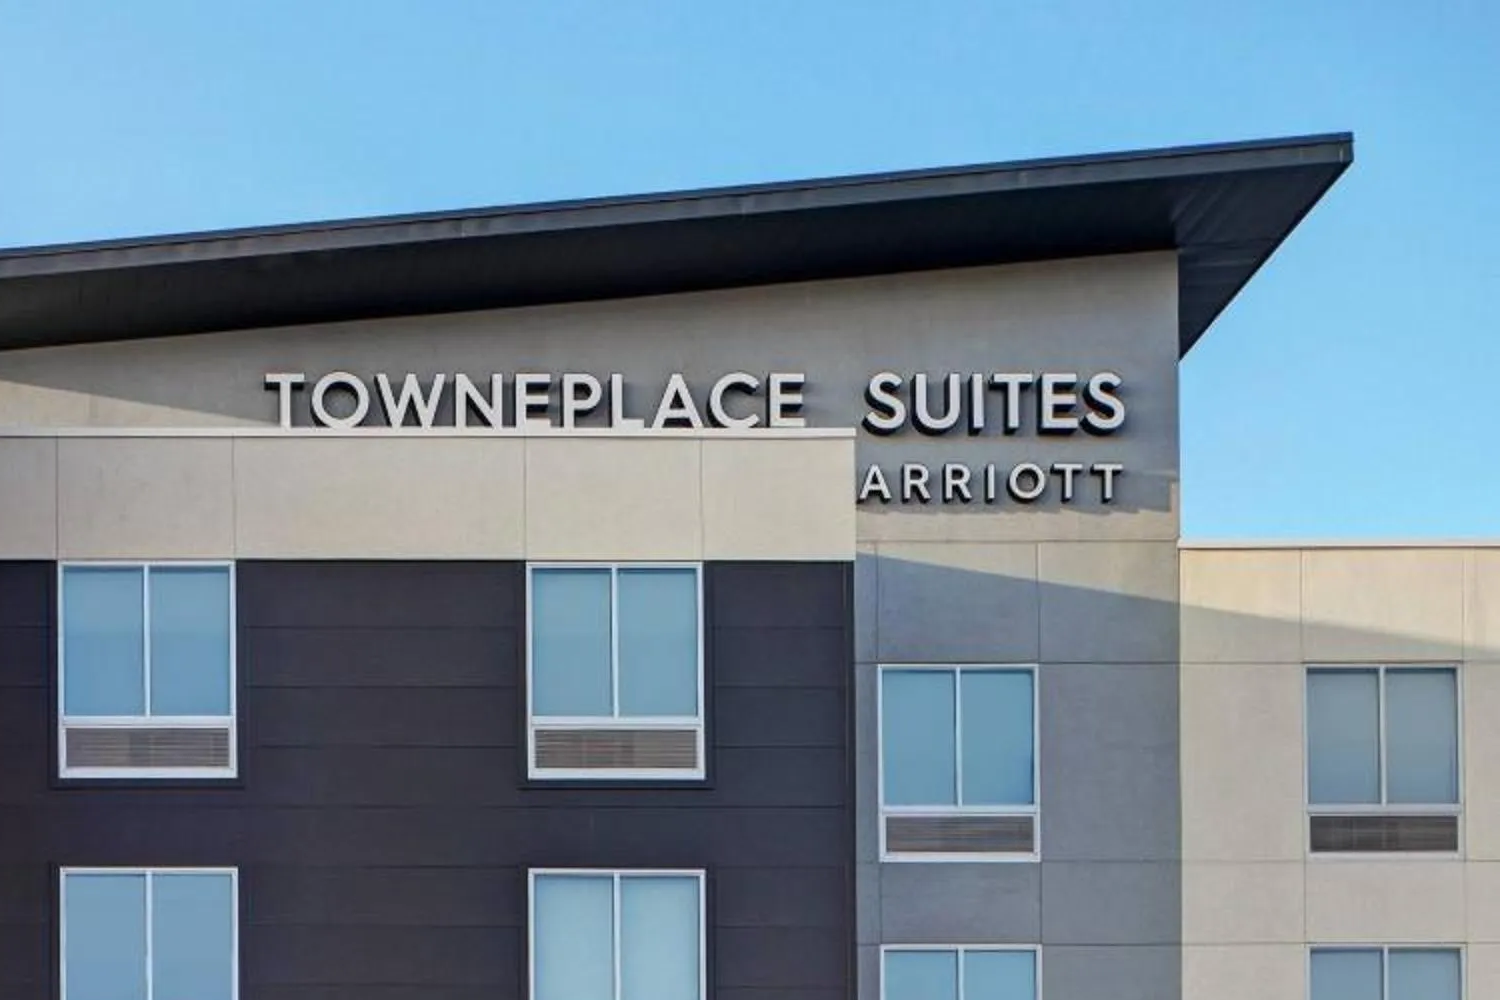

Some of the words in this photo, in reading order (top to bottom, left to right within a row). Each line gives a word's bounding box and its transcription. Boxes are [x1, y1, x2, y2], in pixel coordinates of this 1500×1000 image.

[264, 371, 806, 430] TOWNEPLACE
[862, 371, 1126, 433] SUITES
[858, 463, 1124, 502] ARRIOTT
